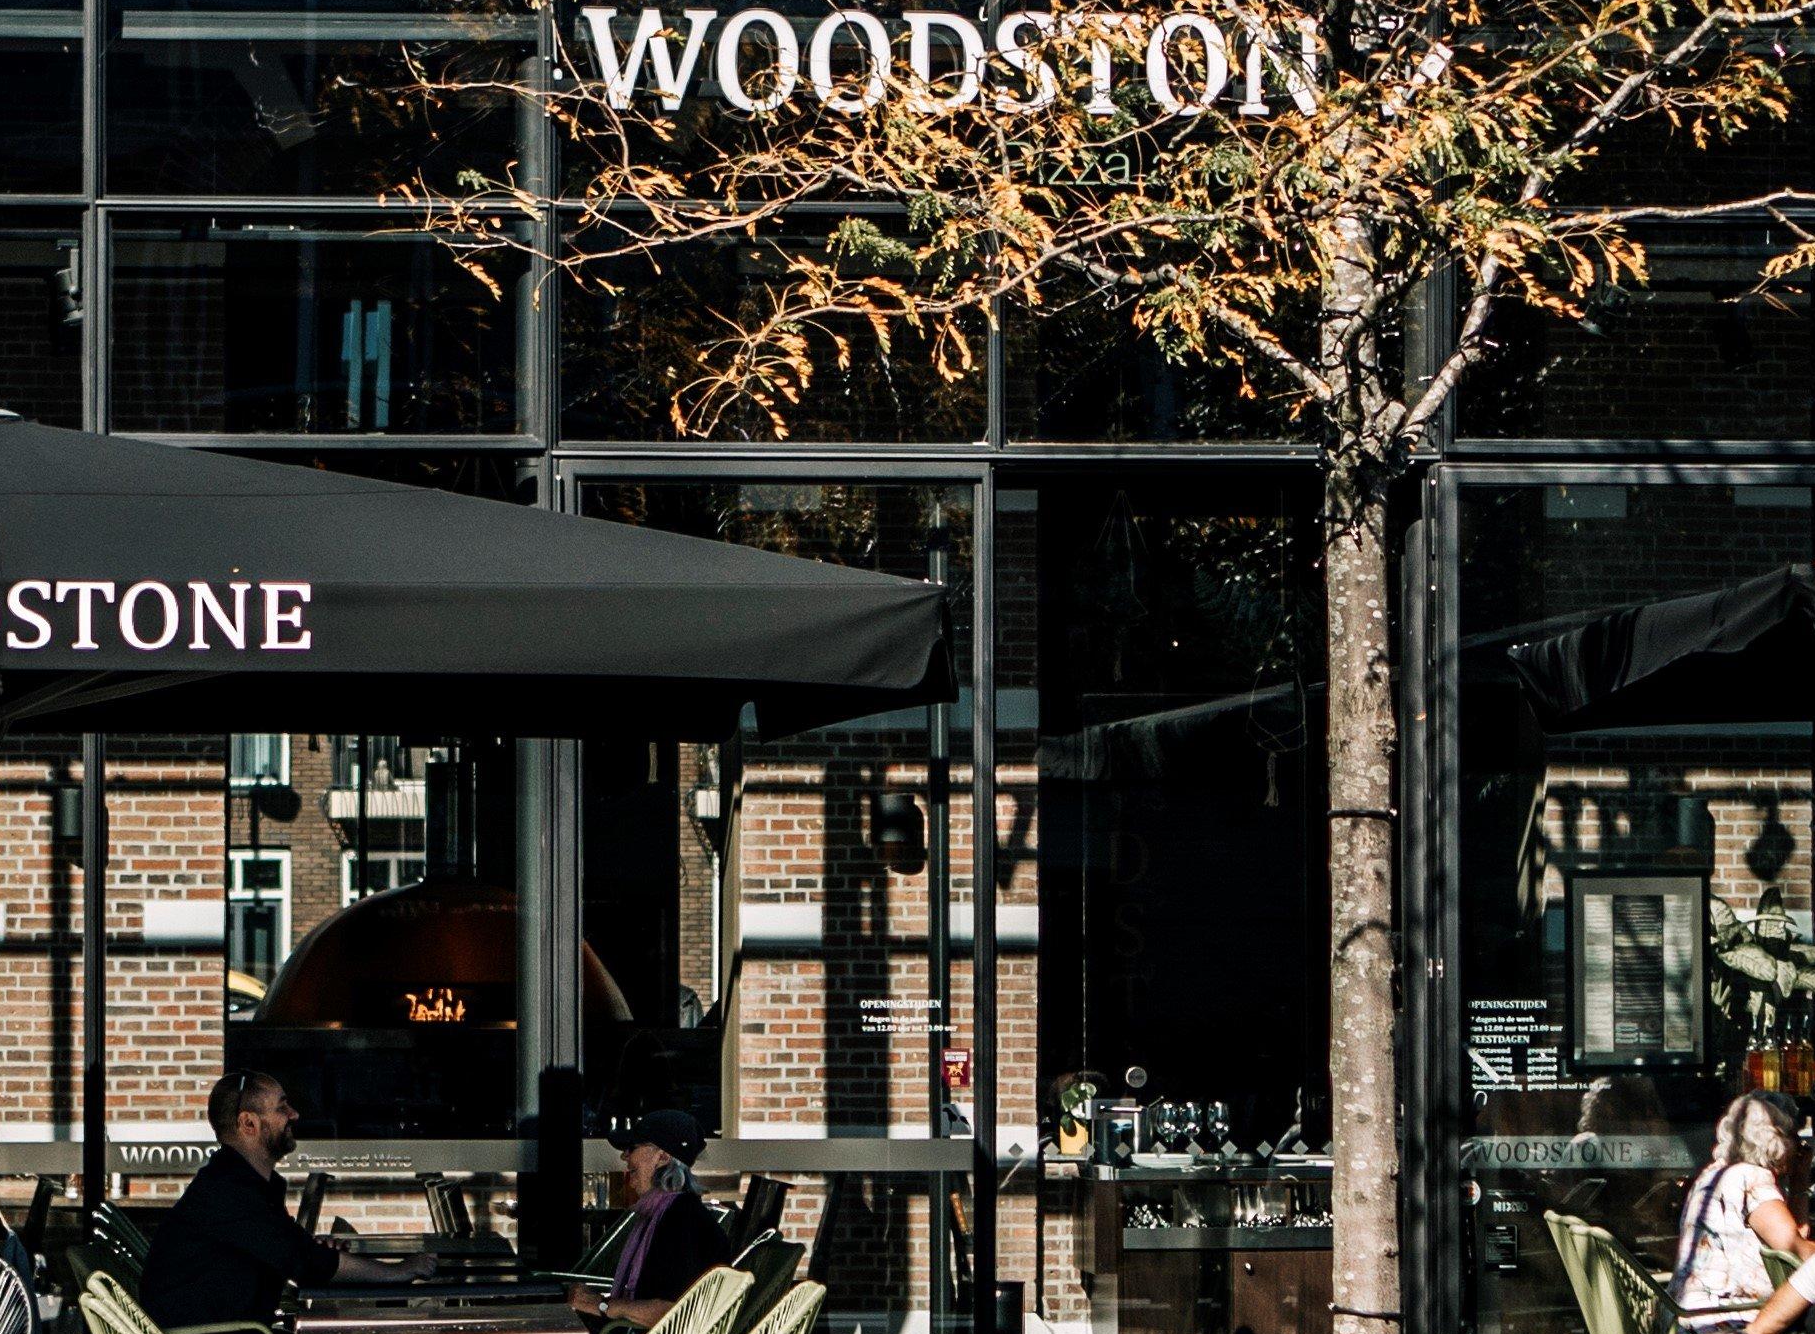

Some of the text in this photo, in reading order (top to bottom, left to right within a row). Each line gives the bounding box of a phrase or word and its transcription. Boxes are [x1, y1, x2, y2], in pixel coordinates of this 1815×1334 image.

[581, 6, 1401, 116] WOODSTON
[1468, 1000, 1547, 1010] OPENINGSTIJDEN
[1470, 1035, 1530, 1044] FEESTDAGEN
[1471, 1141, 1633, 1164] WOODSTONE
